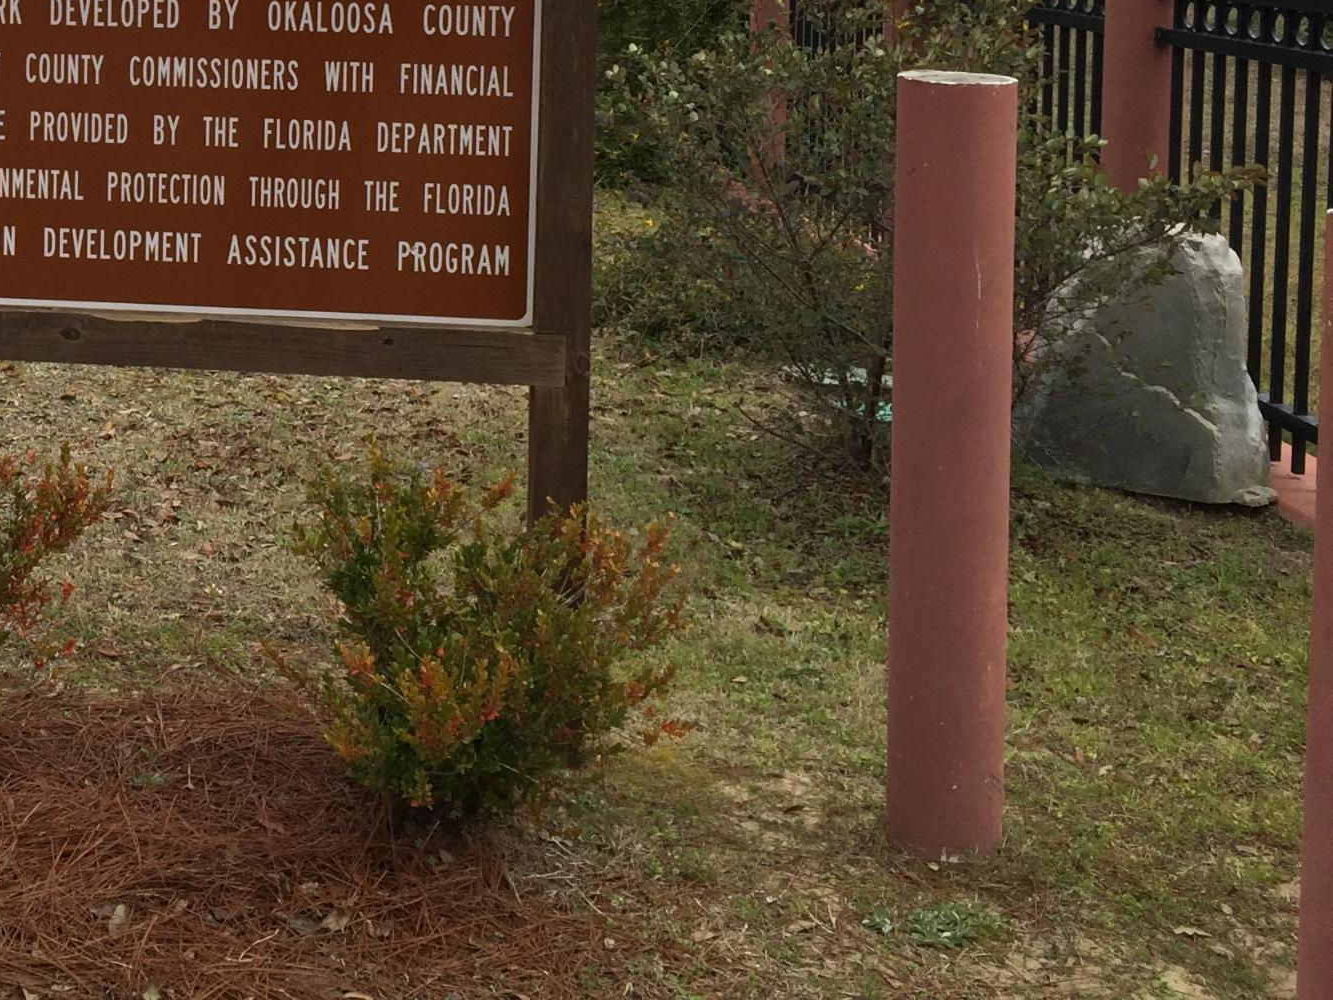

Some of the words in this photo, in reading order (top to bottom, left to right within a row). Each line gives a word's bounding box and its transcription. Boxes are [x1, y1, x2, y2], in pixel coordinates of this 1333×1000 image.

[208, 0, 239, 30] BY
[267, 0, 393, 34] OKALOOSA
[423, 4, 515, 37] COUNTY
[25, 52, 104, 85] COUNTY
[129, 55, 299, 91] COMMISSIONERS
[324, 61, 374, 93] WITH
[400, 63, 514, 97] FINANCIAL
[30, 110, 128, 144] PROVIDED
[153, 114, 180, 146] BY
[202, 116, 239, 148] THE
[263, 118, 351, 151] FLORIDA
[377, 121, 513, 157] DEPARTMENT
[107, 171, 225, 206] PROTECTION
[249, 176, 340, 210] THROUGH
[364, 180, 399, 212] THE
[423, 182, 510, 216] FLORIDA
[43, 227, 202, 263] DEVELOPMENT
[227, 234, 369, 270] ASSISTANCE
[397, 240, 510, 276] PROGRAM
